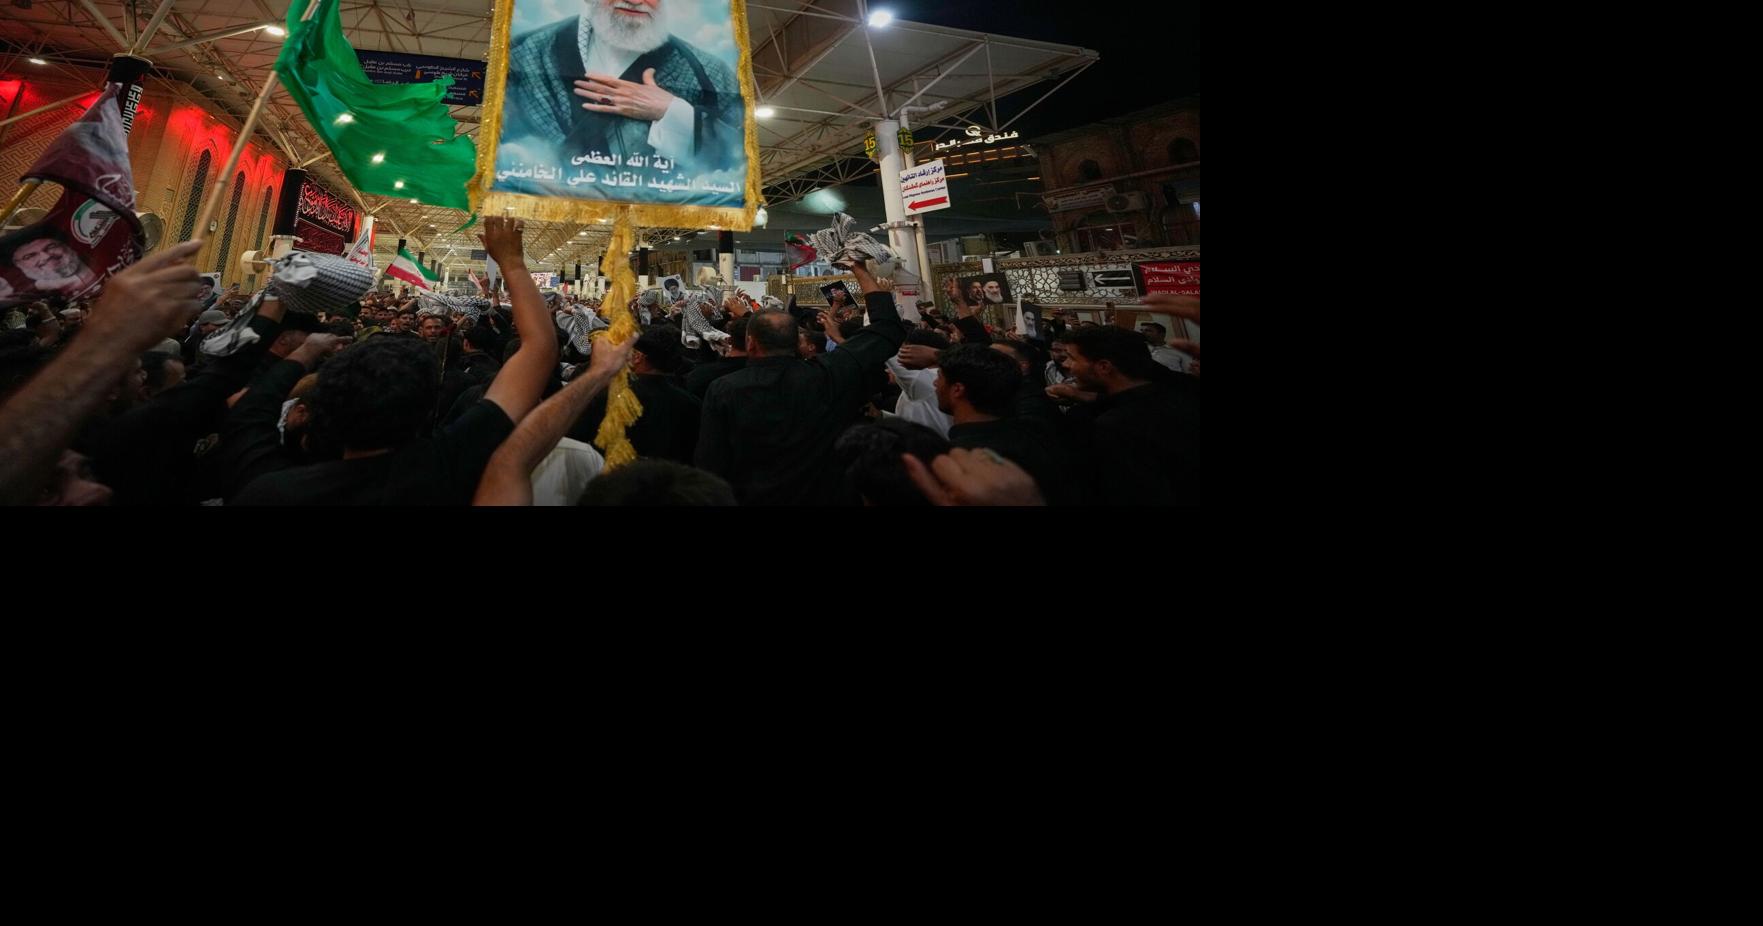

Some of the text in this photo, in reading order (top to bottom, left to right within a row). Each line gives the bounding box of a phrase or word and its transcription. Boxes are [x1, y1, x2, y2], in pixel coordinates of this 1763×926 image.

[864, 136, 876, 151] 15
[898, 134, 913, 146] 15
[984, 130, 1019, 144] فندق
[571, 150, 622, 167] العظمى
[626, 152, 648, 168] الله
[930, 166, 943, 175] مركز
[648, 173, 697, 194] الشهيد
[701, 179, 742, 196] السيد
[1147, 276, 1175, 285] السلام
